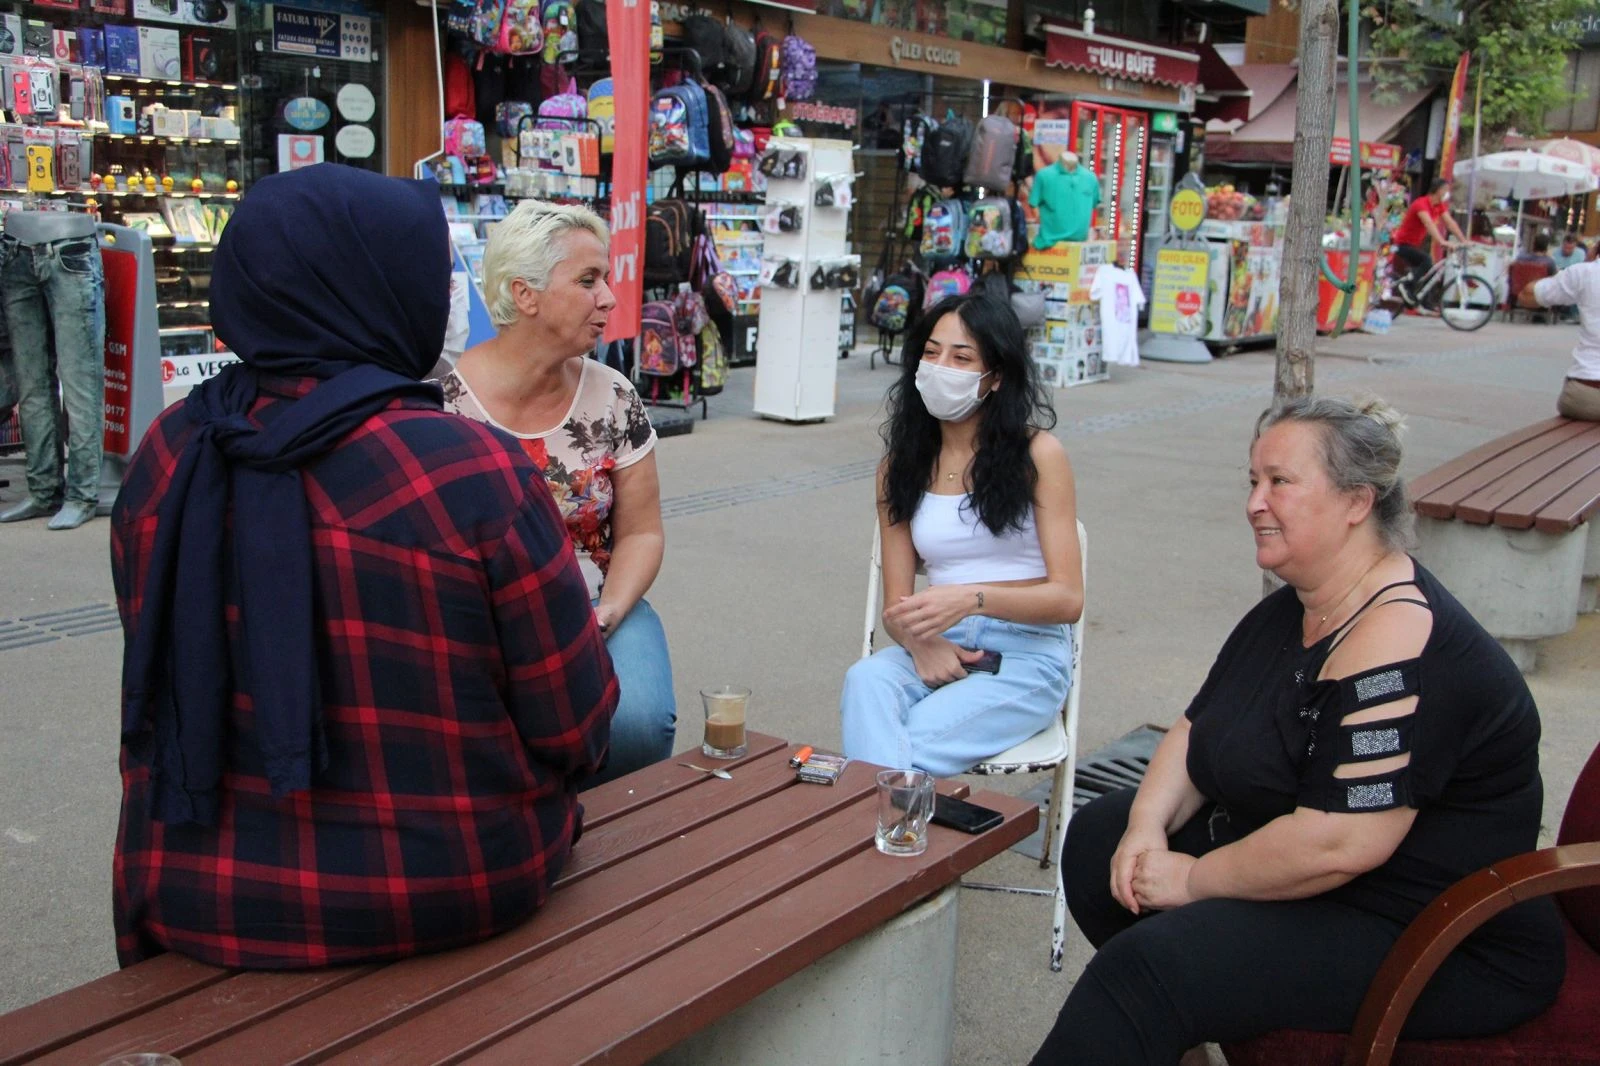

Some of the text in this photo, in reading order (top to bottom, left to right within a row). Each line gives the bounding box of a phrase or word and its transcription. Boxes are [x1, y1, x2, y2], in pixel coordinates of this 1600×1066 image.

[277, 11, 310, 25] FATURA
[1100, 47, 1125, 70] ULU
[1126, 50, 1156, 76] BÜFE
[1171, 201, 1201, 217] FOTO
[108, 341, 127, 356] GSM
[176, 366, 190, 376] LG
[105, 404, 125, 417] 0177
